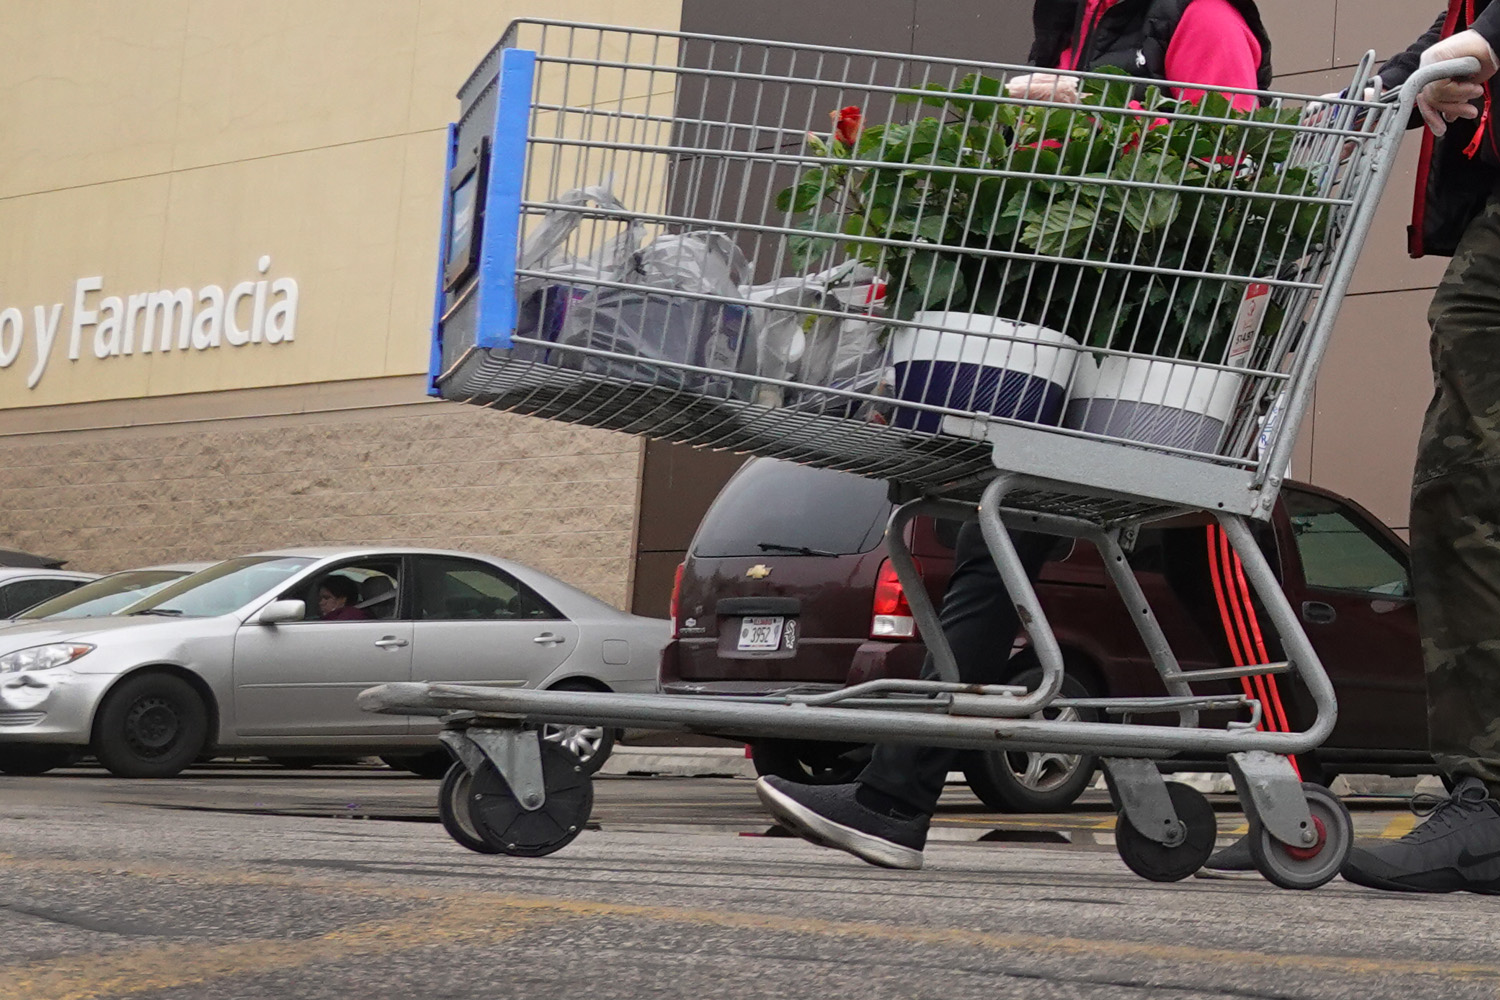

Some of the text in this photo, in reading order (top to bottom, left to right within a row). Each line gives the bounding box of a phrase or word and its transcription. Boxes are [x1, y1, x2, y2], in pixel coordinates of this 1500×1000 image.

[27, 303, 64, 390] y
[68, 255, 299, 361] Farmacia
[750, 627, 771, 643] 3952
